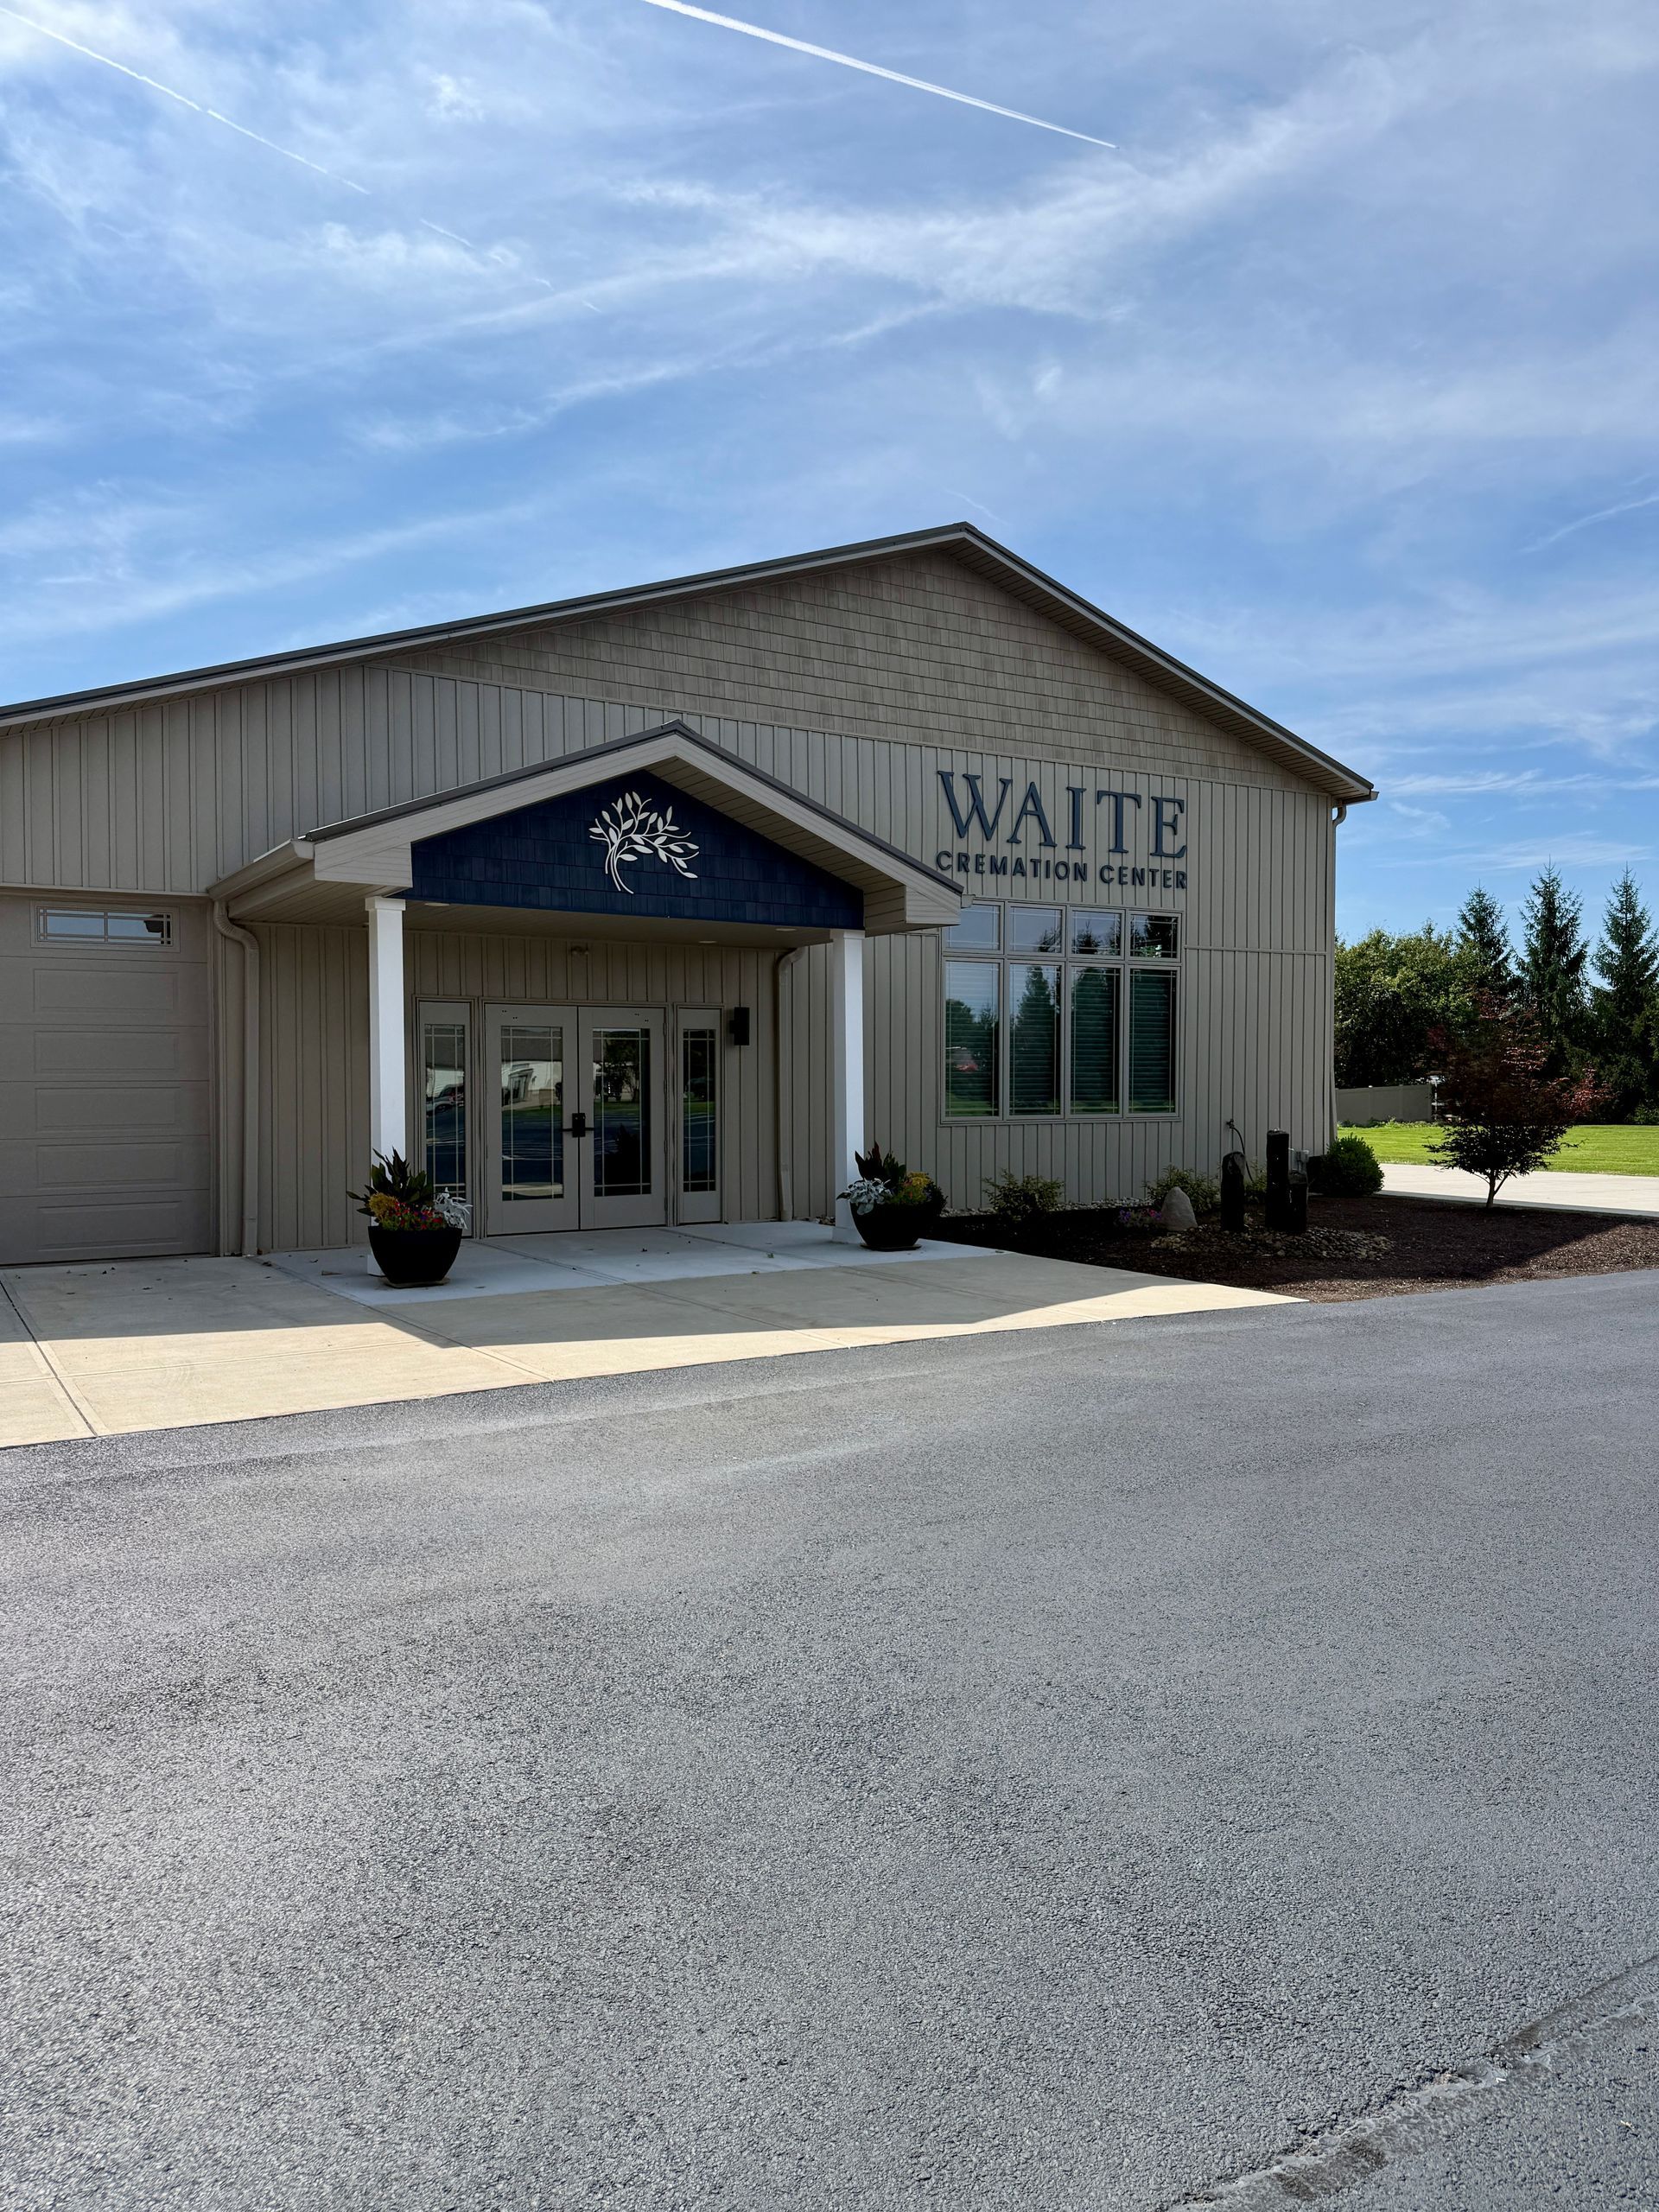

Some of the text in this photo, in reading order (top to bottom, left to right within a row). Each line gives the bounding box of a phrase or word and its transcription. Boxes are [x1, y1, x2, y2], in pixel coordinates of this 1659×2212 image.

[937, 770, 1187, 858] WAITE
[936, 850, 1187, 889] CREMATION CENTER
